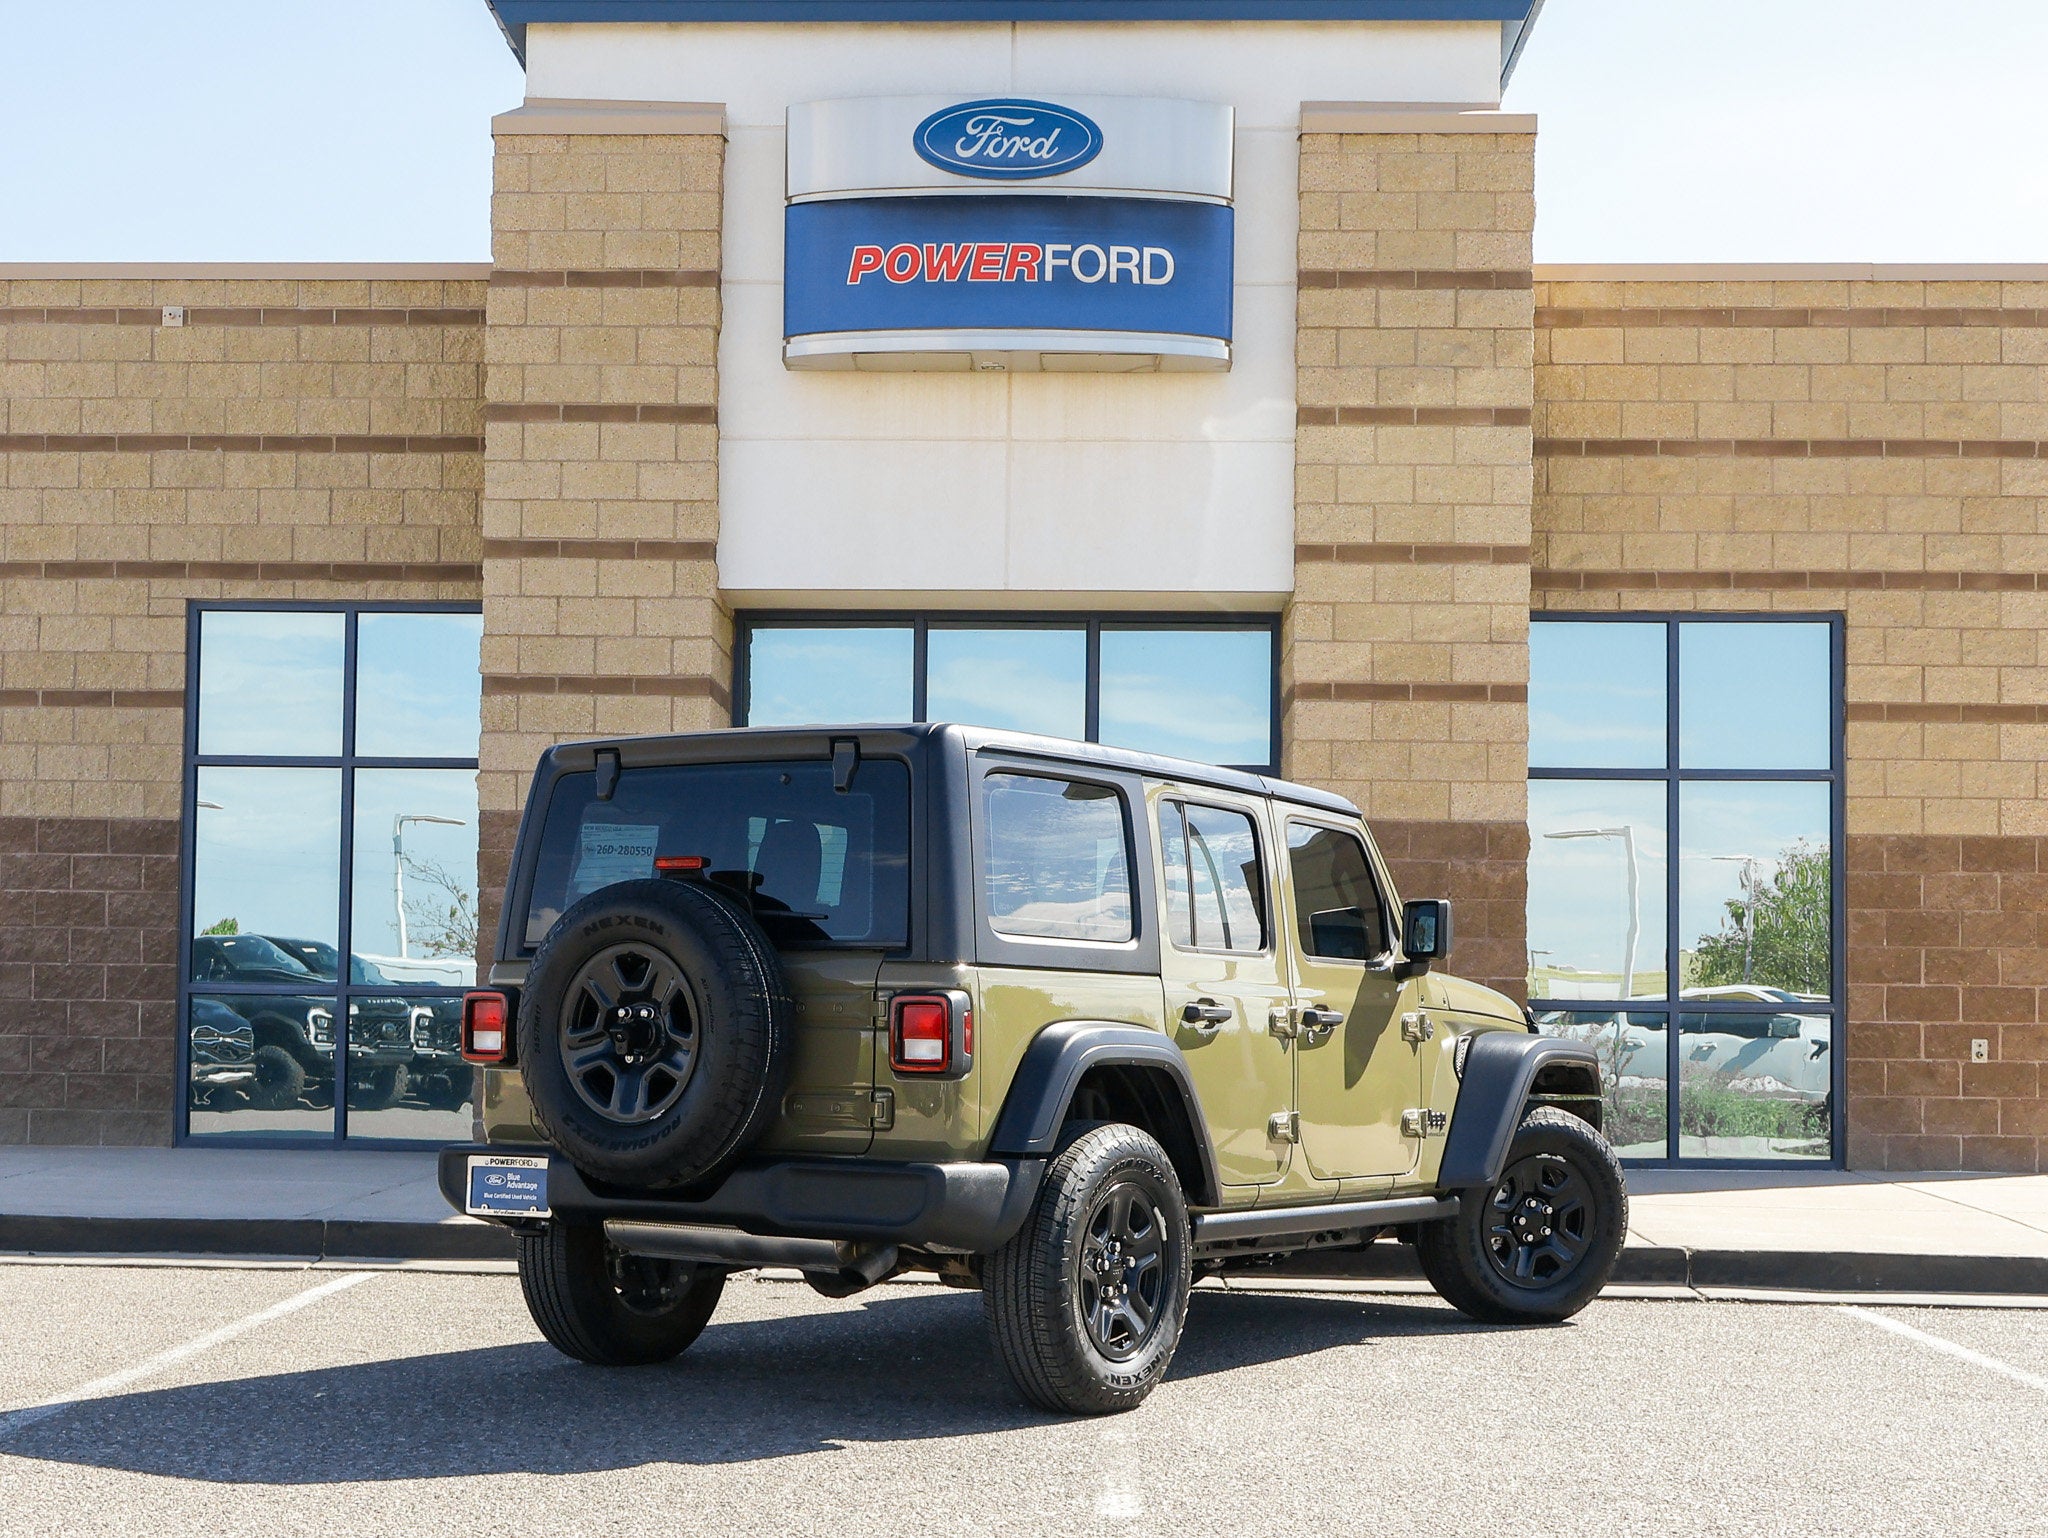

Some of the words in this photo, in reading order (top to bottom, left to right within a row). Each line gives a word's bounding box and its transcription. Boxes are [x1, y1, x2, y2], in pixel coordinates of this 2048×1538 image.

[954, 115, 1059, 159] Ford
[846, 242, 1175, 285] POWERFORD
[596, 844, 653, 857] 26D-280550
[583, 914, 664, 935] NEXEN
[490, 1158, 533, 1166] POWERFORD
[488, 1175, 502, 1184] Ford
[507, 1173, 520, 1181] Blue
[507, 1181, 538, 1191] Advantage
[1110, 1353, 1161, 1386] NEXEN
